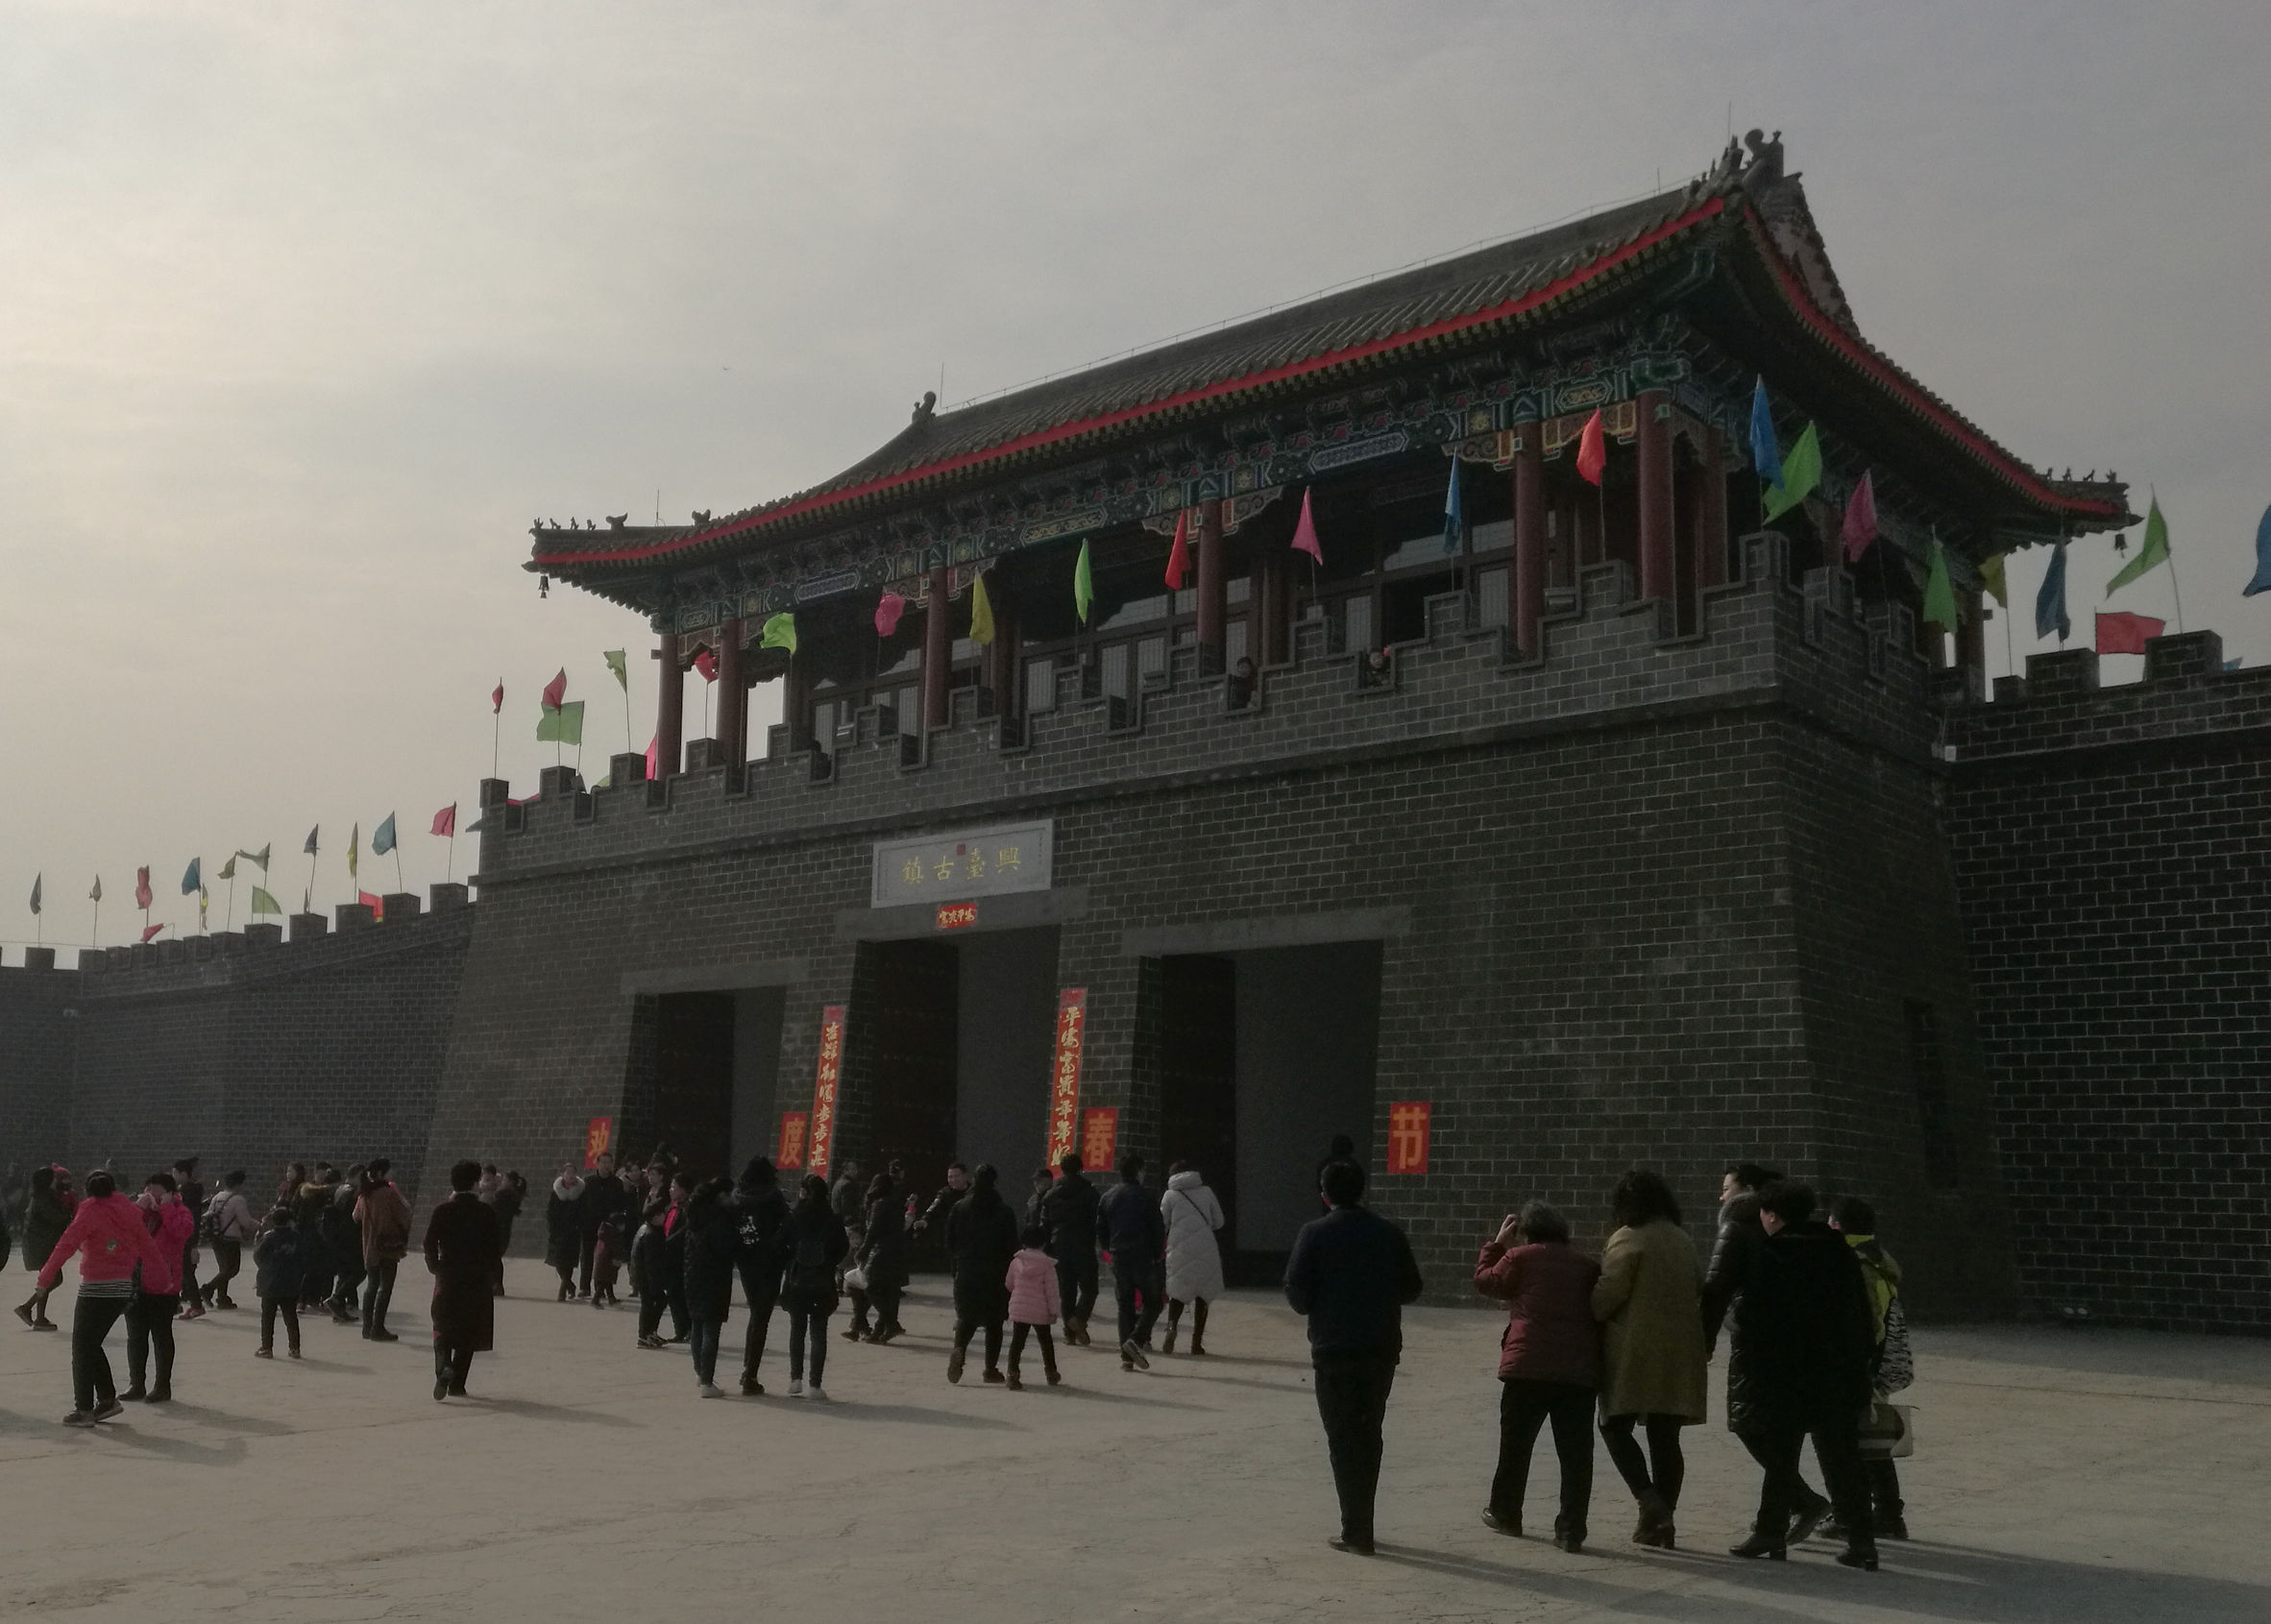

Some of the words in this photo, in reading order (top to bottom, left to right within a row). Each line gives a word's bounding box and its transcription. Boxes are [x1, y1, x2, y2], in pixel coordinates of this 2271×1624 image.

[780, 1117, 805, 1166] 度
[1085, 1112, 1113, 1167] 春
[1392, 1106, 1427, 1169] 节
